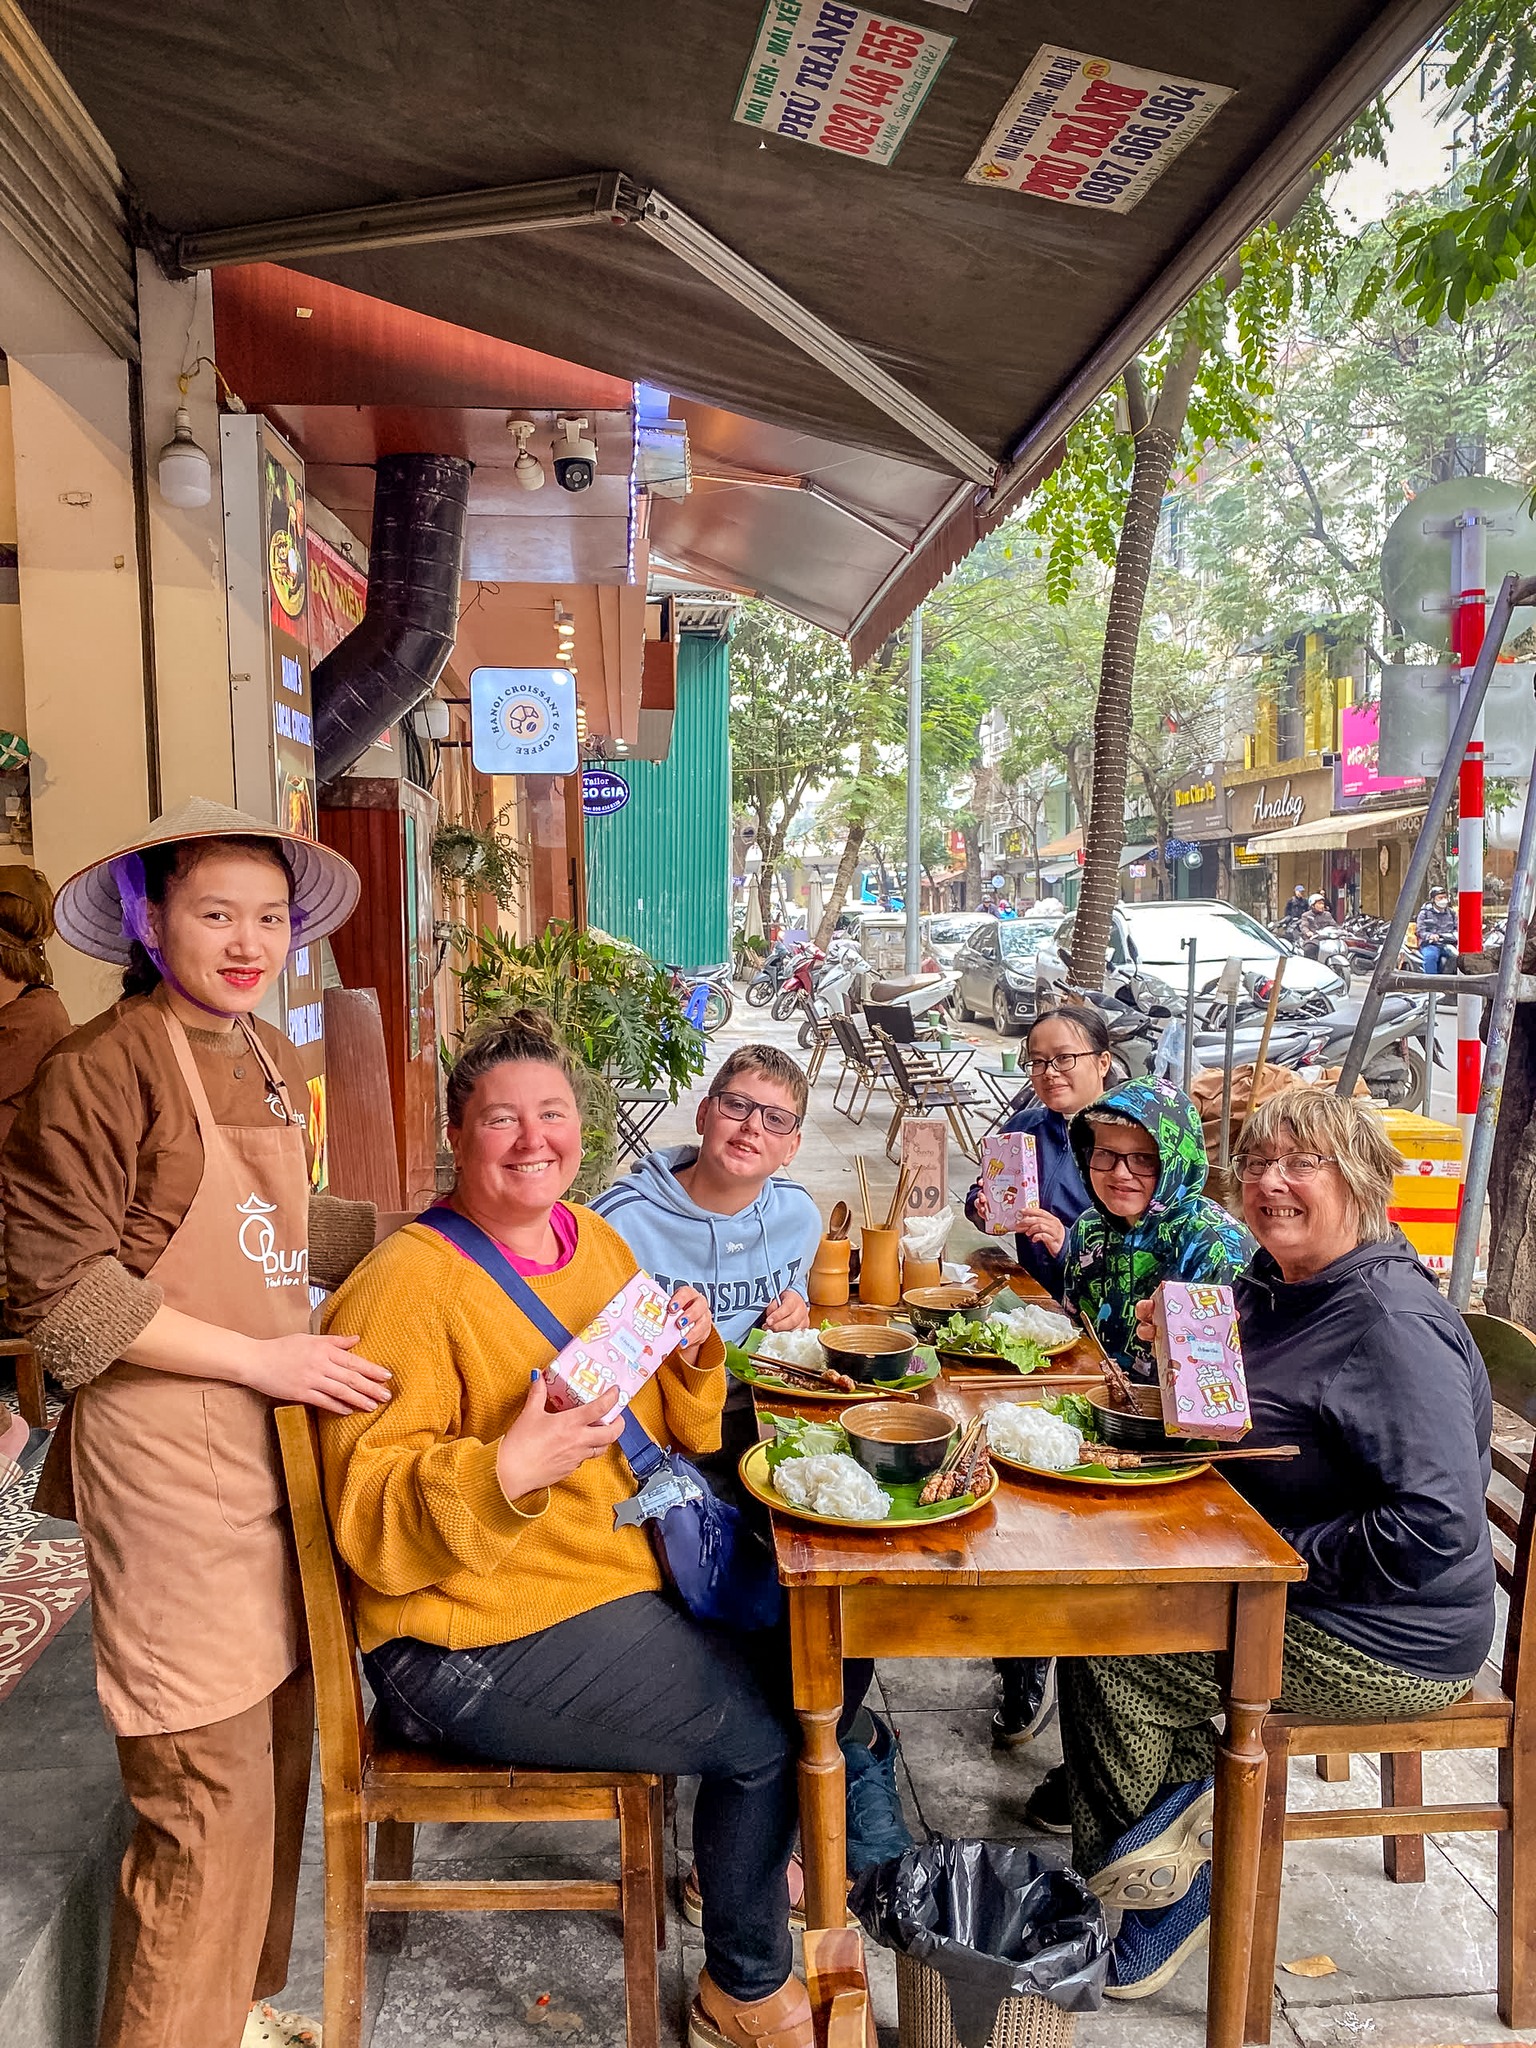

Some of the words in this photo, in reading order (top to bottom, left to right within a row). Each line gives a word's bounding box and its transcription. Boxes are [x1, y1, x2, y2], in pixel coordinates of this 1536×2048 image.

[752, 63, 780, 98] HIÊN
[766, 26, 793, 57] MÁI
[795, 1, 859, 91] THÀNH
[856, 19, 925, 70] 555
[839, 64, 904, 108] 446
[778, 91, 821, 140] PHÚ
[819, 103, 886, 155] 0929
[1075, 84, 1206, 205] 0987.666.964
[1020, 153, 1090, 200] PHÚ
[490, 696, 503, 734] HANOI
[505, 684, 560, 718] CROISSANT
[515, 735, 556, 755] COFFEE
[583, 778, 609, 786] Tailor
[601, 787, 625, 798] GIA
[1253, 780, 1305, 826] Analog
[908, 1185, 940, 1209] 09
